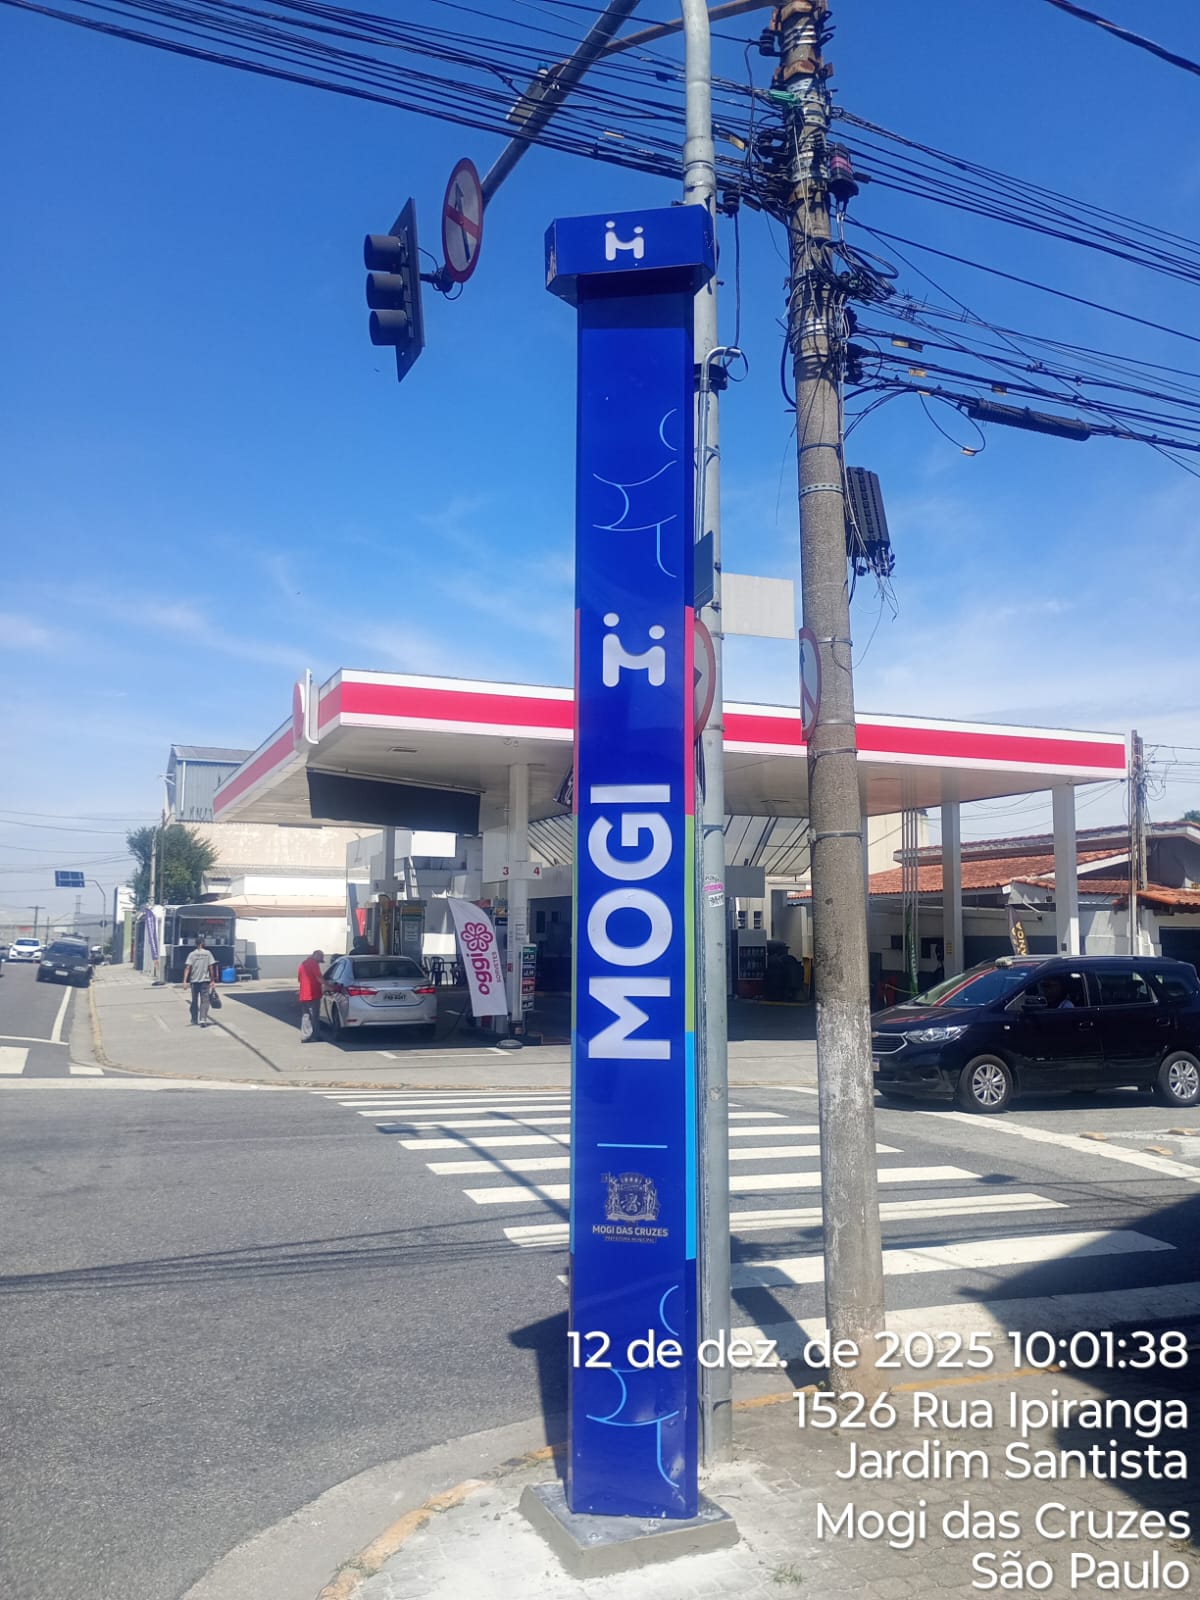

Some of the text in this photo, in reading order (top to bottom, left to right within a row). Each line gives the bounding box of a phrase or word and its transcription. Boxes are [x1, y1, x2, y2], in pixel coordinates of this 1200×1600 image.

[502, 866, 541, 876] 3 4
[587, 784, 672, 1059] MOGI
[466, 952, 493, 996] oggi
[592, 1225, 668, 1237] MOGI DAS CRUZES
